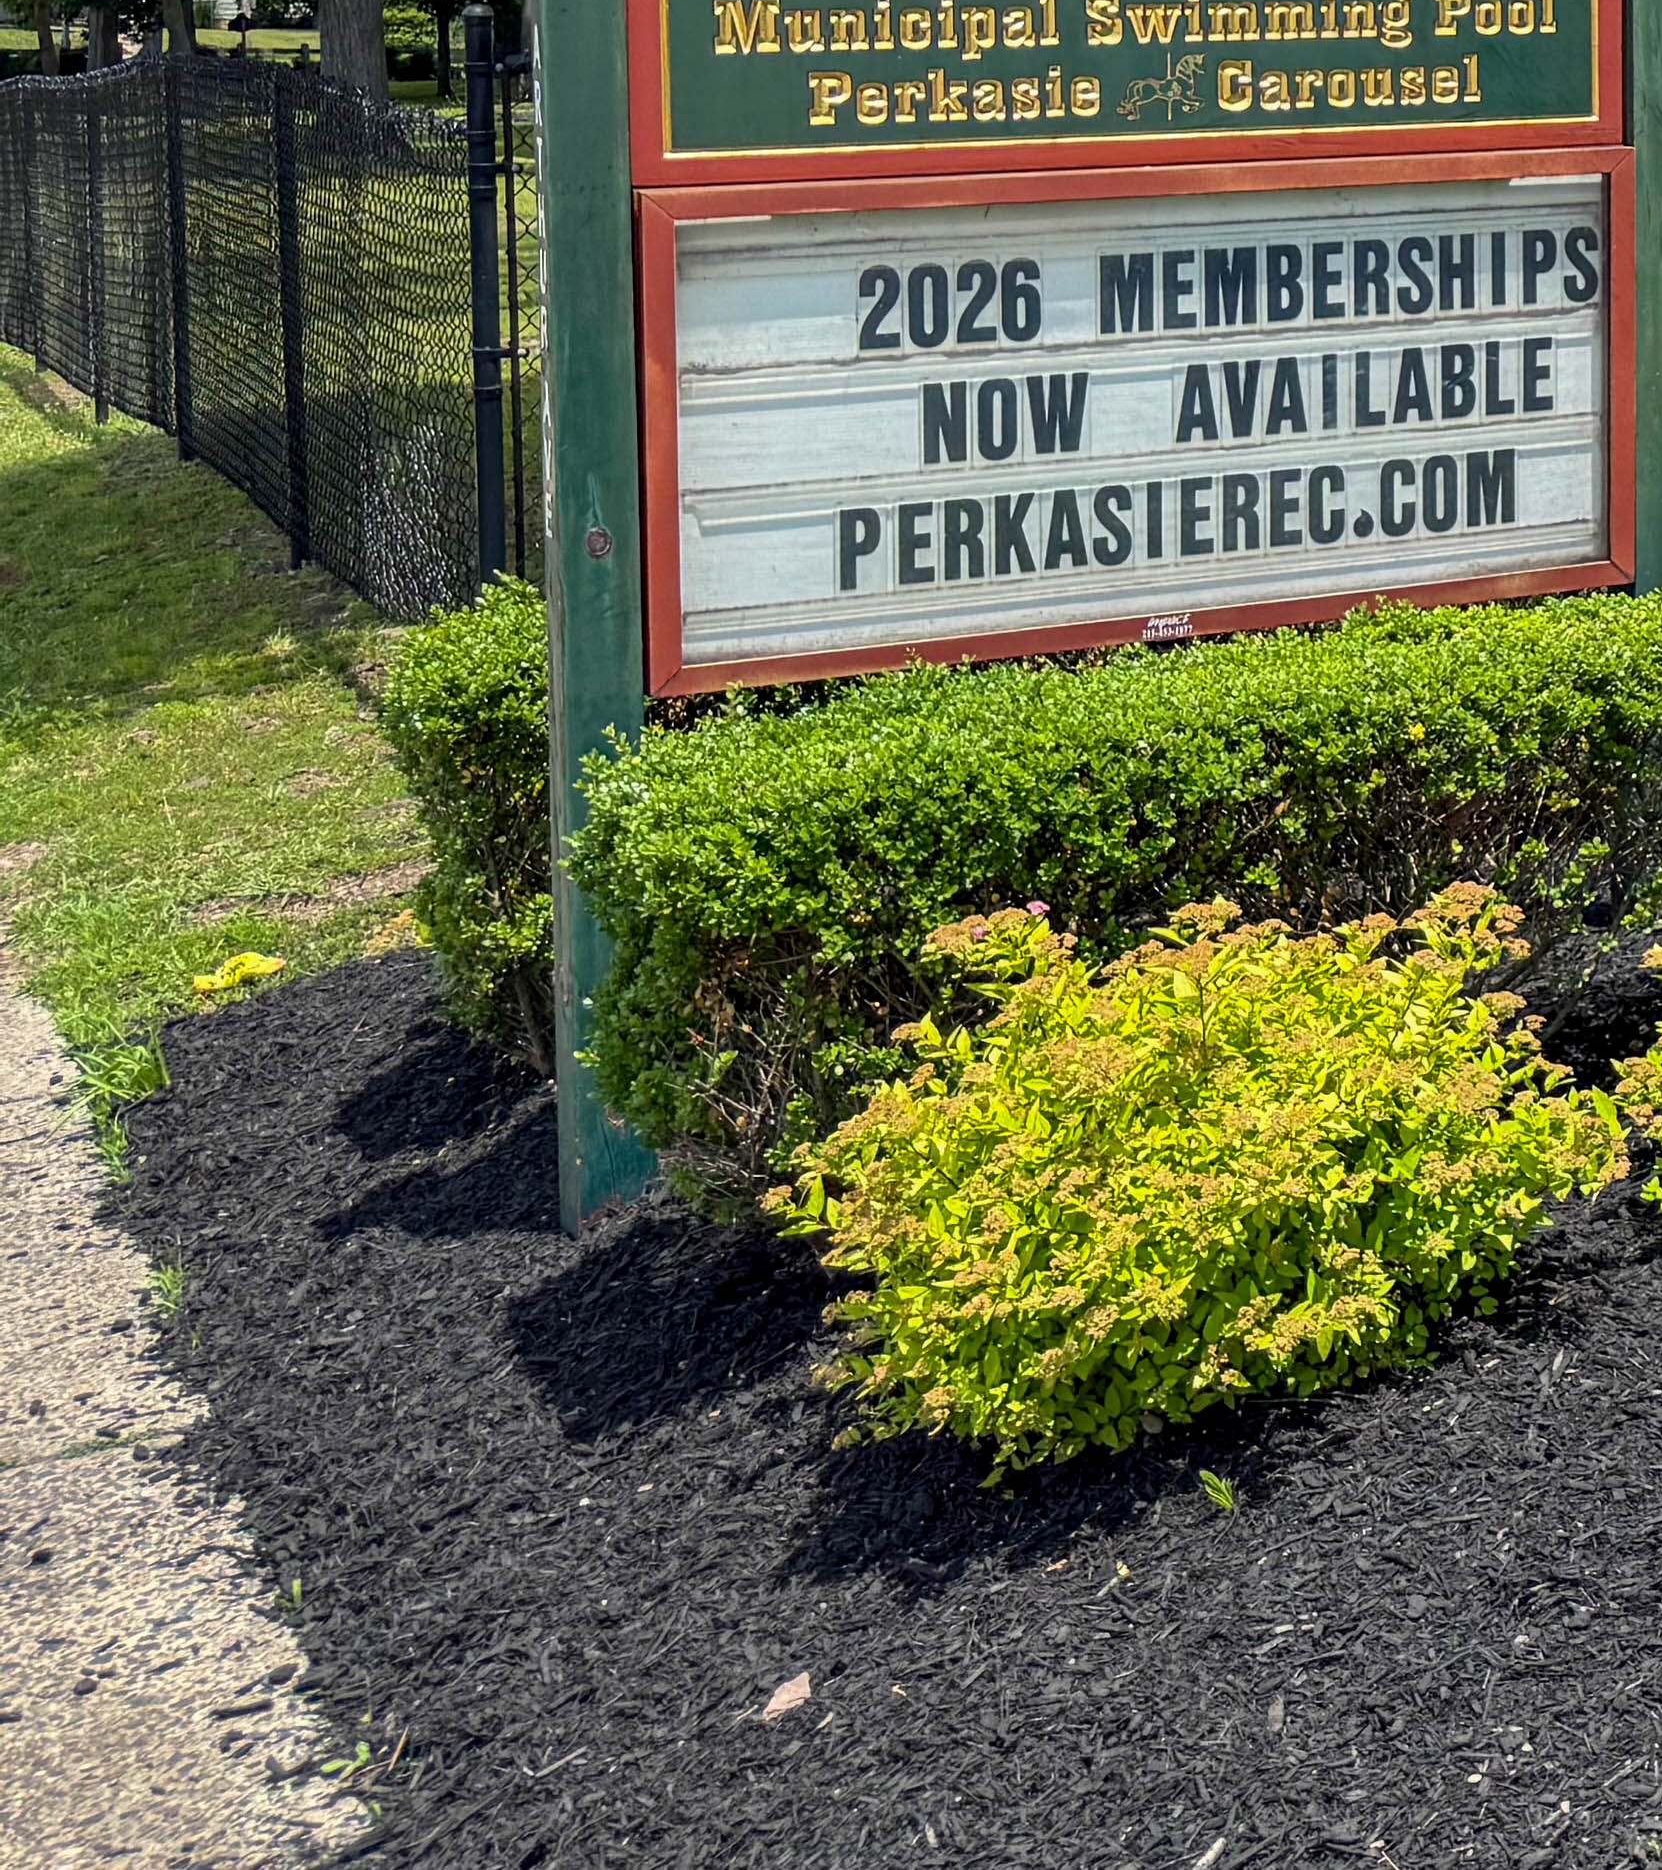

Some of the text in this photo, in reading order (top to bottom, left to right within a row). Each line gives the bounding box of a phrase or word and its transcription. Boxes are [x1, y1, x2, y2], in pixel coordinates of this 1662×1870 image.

[808, 53, 1482, 126] Perkasie Carousel
[533, 23, 547, 352] ARTHUR
[543, 380, 552, 538] AVE
[859, 226, 1599, 350] 2026 MEMBERSHIPS
[923, 337, 1555, 464] NOW AVAILABLE
[839, 448, 1516, 591] PERKASIEREC.COM
